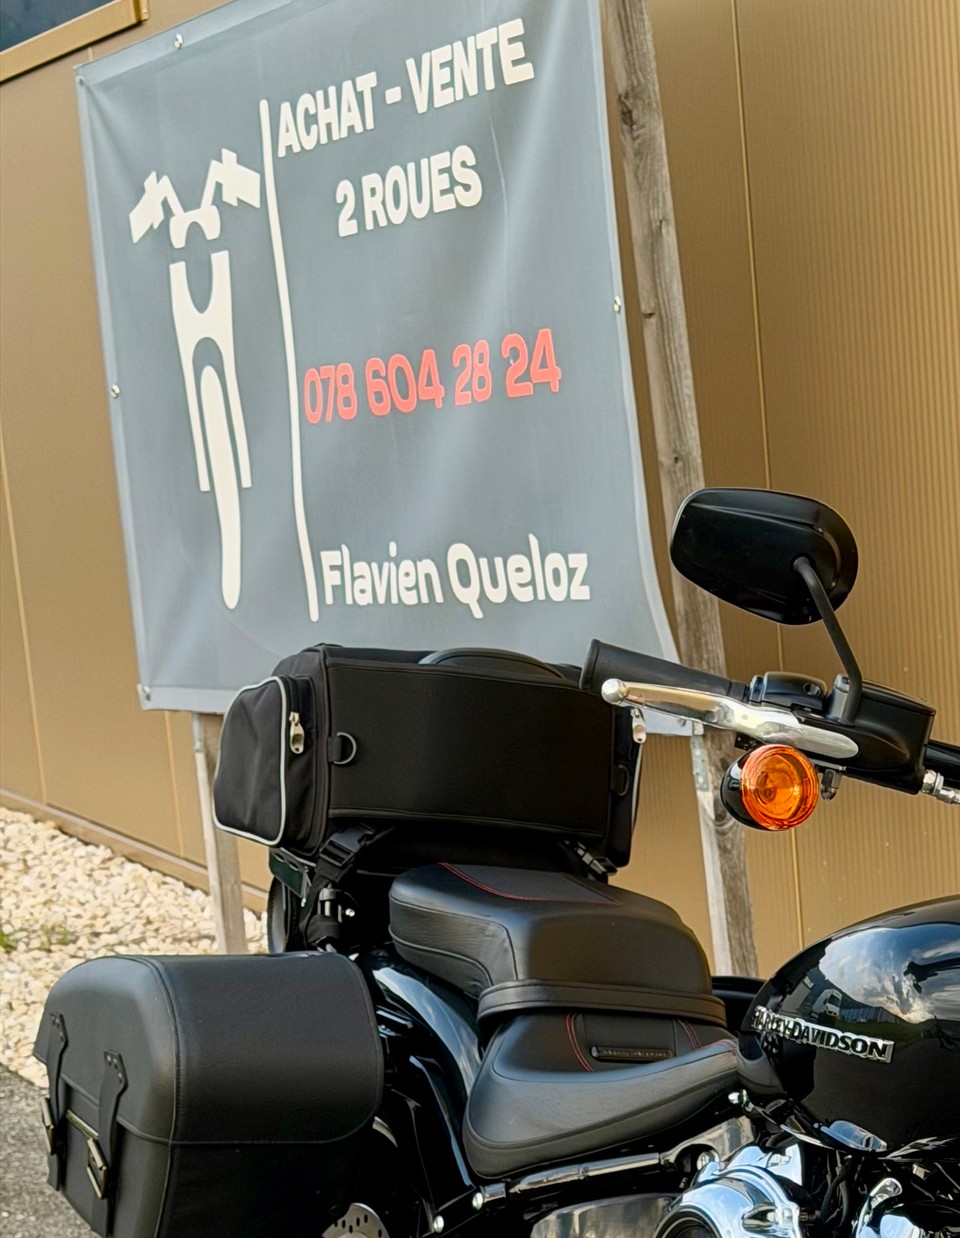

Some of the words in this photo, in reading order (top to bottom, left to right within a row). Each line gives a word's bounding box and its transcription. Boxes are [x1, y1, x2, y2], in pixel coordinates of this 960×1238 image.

[277, 71, 377, 157] ACHAT
[385, 86, 402, 104] -
[405, 18, 535, 114] VENTE
[335, 179, 358, 237] 2
[361, 144, 482, 231] ROUES
[304, 362, 358, 424] 078
[365, 348, 445, 416] 604
[452, 339, 492, 406] 28
[501, 328, 561, 398] 24
[319, 541, 444, 606] Flavien
[447, 533, 590, 619] Queloz
[751, 1006, 892, 1062] HARLEY-DAVIDSON
